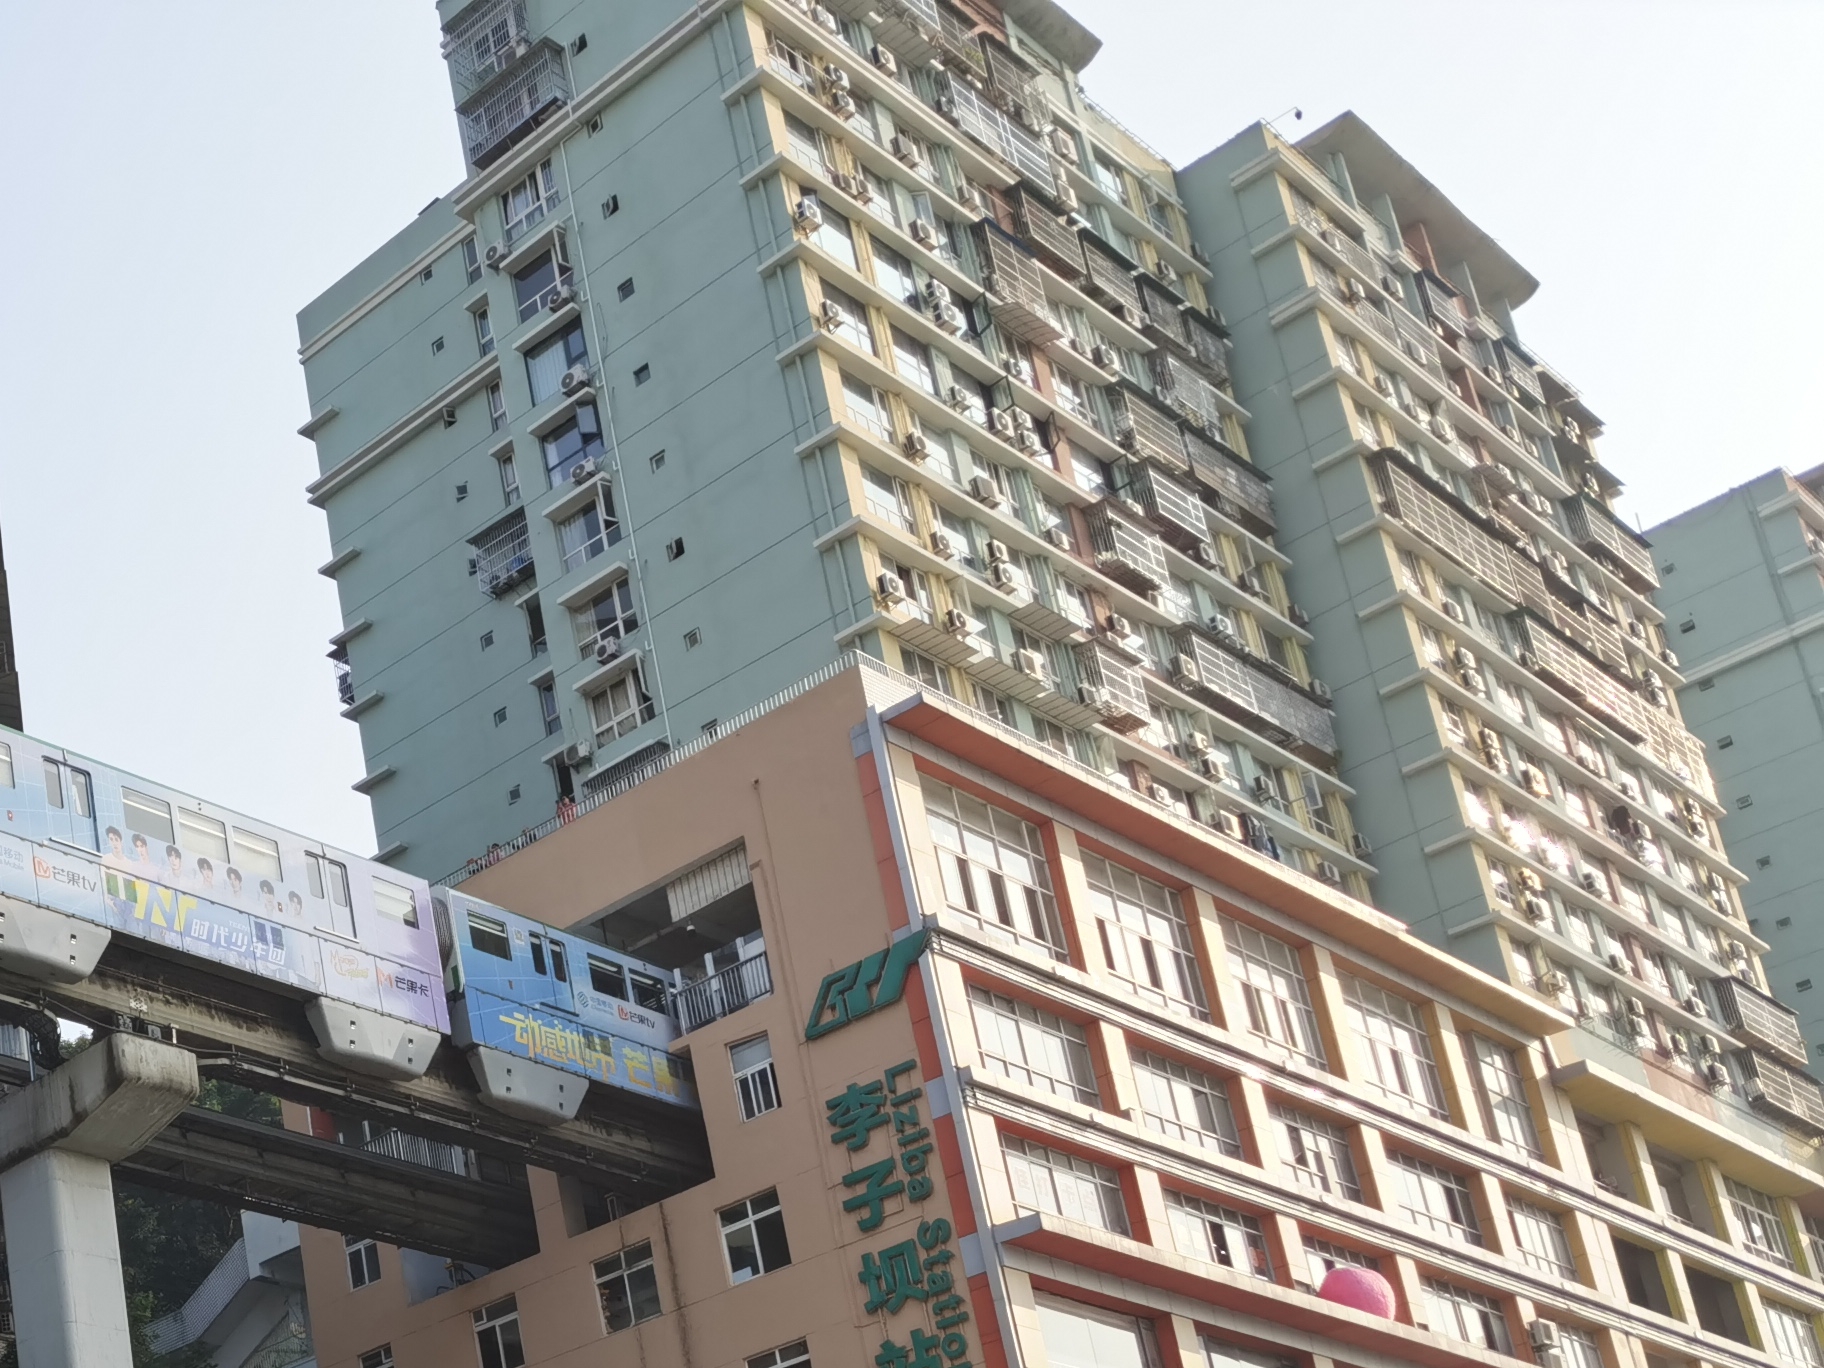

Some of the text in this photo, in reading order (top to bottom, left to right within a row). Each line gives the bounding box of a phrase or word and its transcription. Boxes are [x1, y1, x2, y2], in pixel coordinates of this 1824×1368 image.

[191, 918, 288, 966] 时代少年团
[394, 975, 430, 998] 芒果卡
[884, 1057, 934, 1205] Liziba
